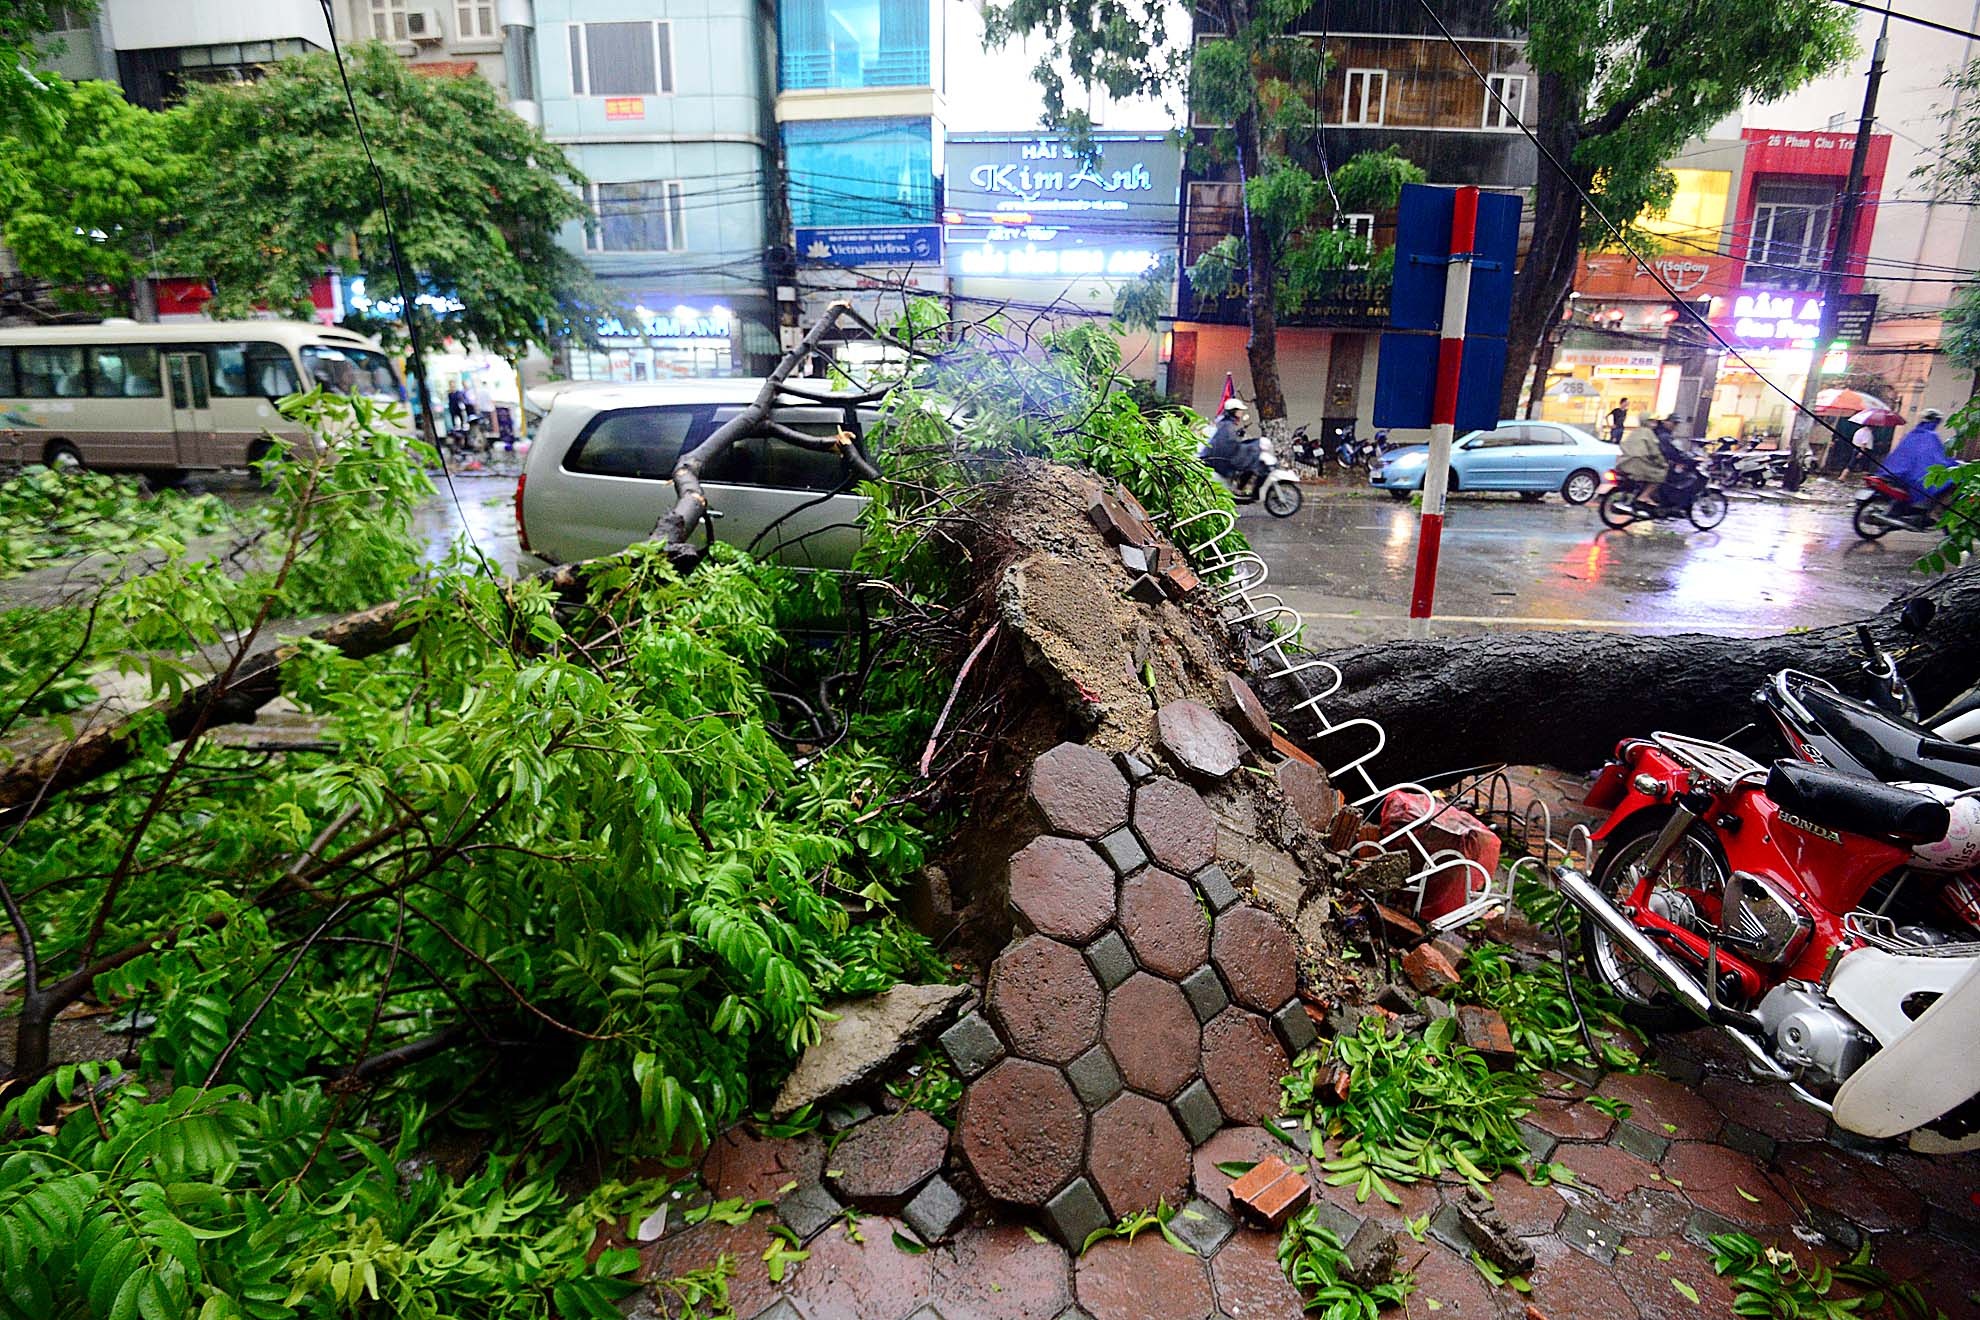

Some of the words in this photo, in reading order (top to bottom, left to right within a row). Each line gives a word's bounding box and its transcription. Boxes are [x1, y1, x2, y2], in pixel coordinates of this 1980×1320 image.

[1784, 136, 1811, 148] Phan
[1814, 138, 1835, 149] Chu
[1839, 139, 1857, 150] Tri
[970, 163, 1064, 201] Kim
[832, 243, 873, 255] Vietnam
[873, 242, 911, 254] Airlines
[1777, 809, 1843, 845] HONDA
